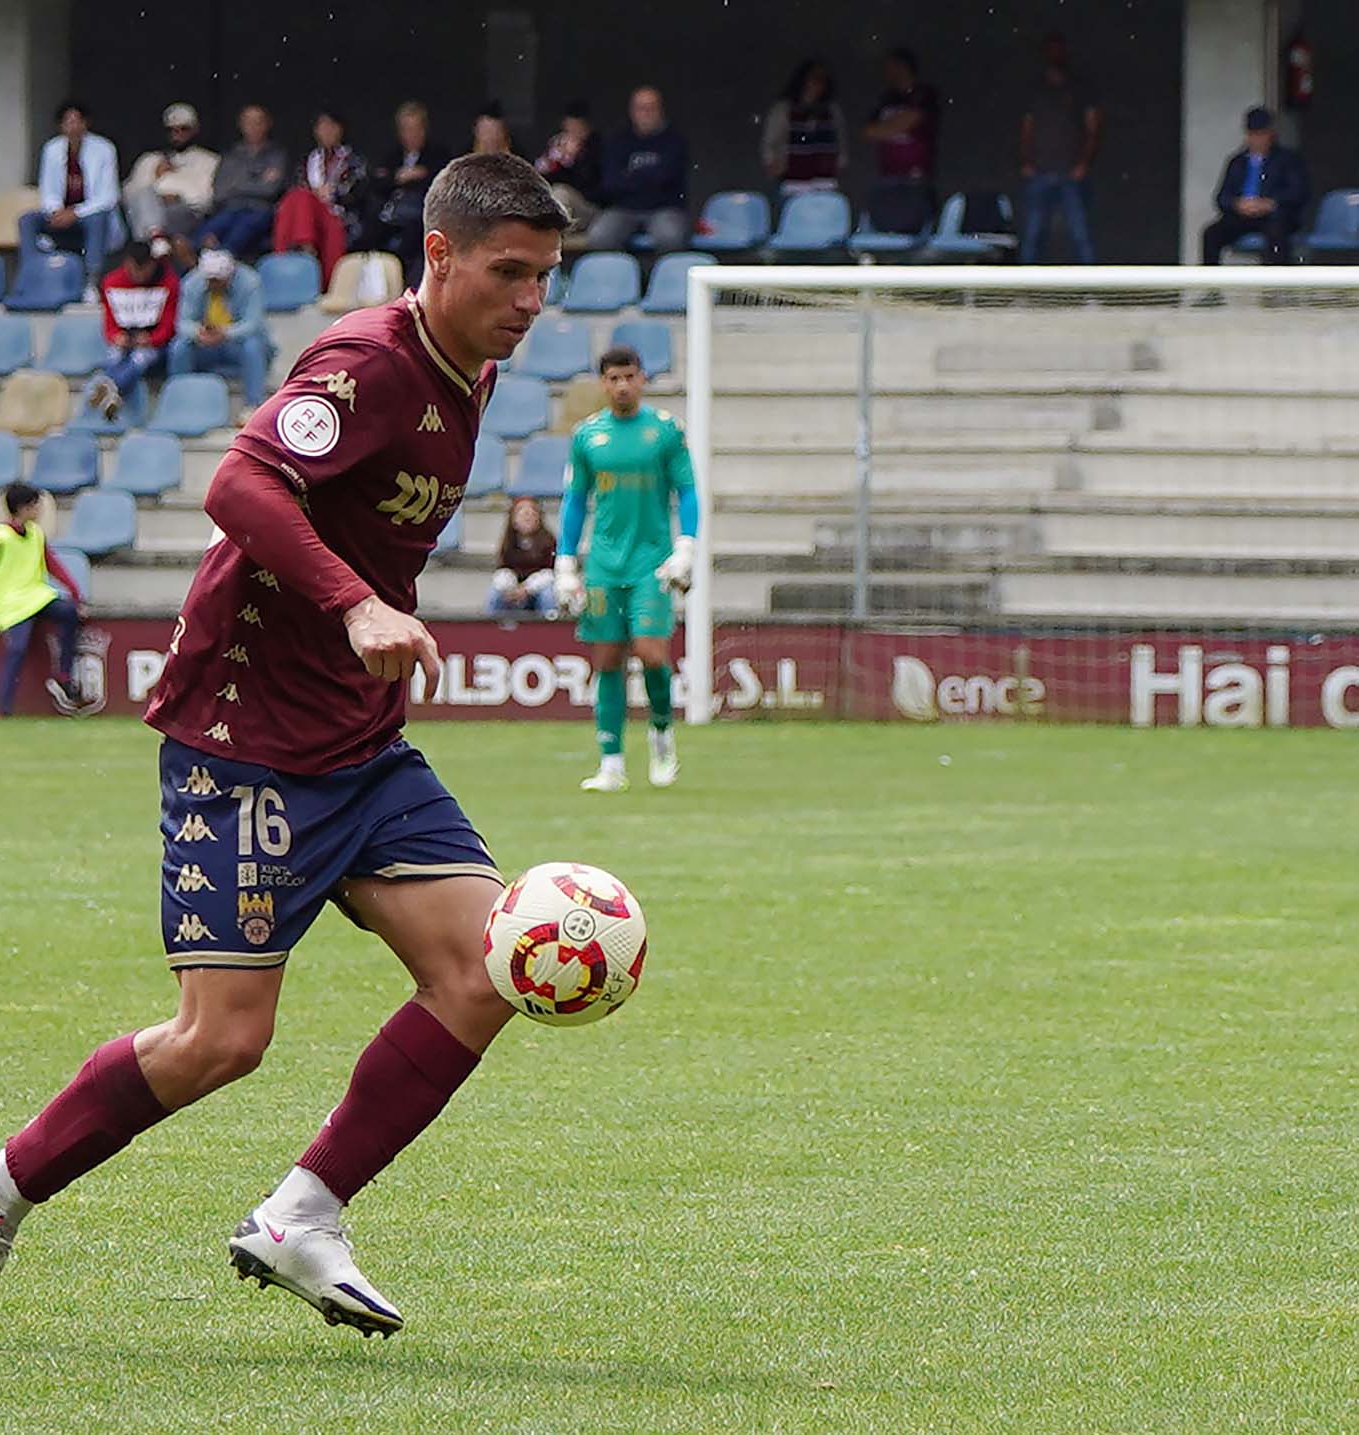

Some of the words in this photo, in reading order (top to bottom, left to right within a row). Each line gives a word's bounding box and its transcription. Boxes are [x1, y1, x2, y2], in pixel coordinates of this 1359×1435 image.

[127, 650, 165, 702] P
[937, 675, 1046, 714] ence
[1130, 644, 1291, 728] Hai
[230, 786, 292, 857] 16
